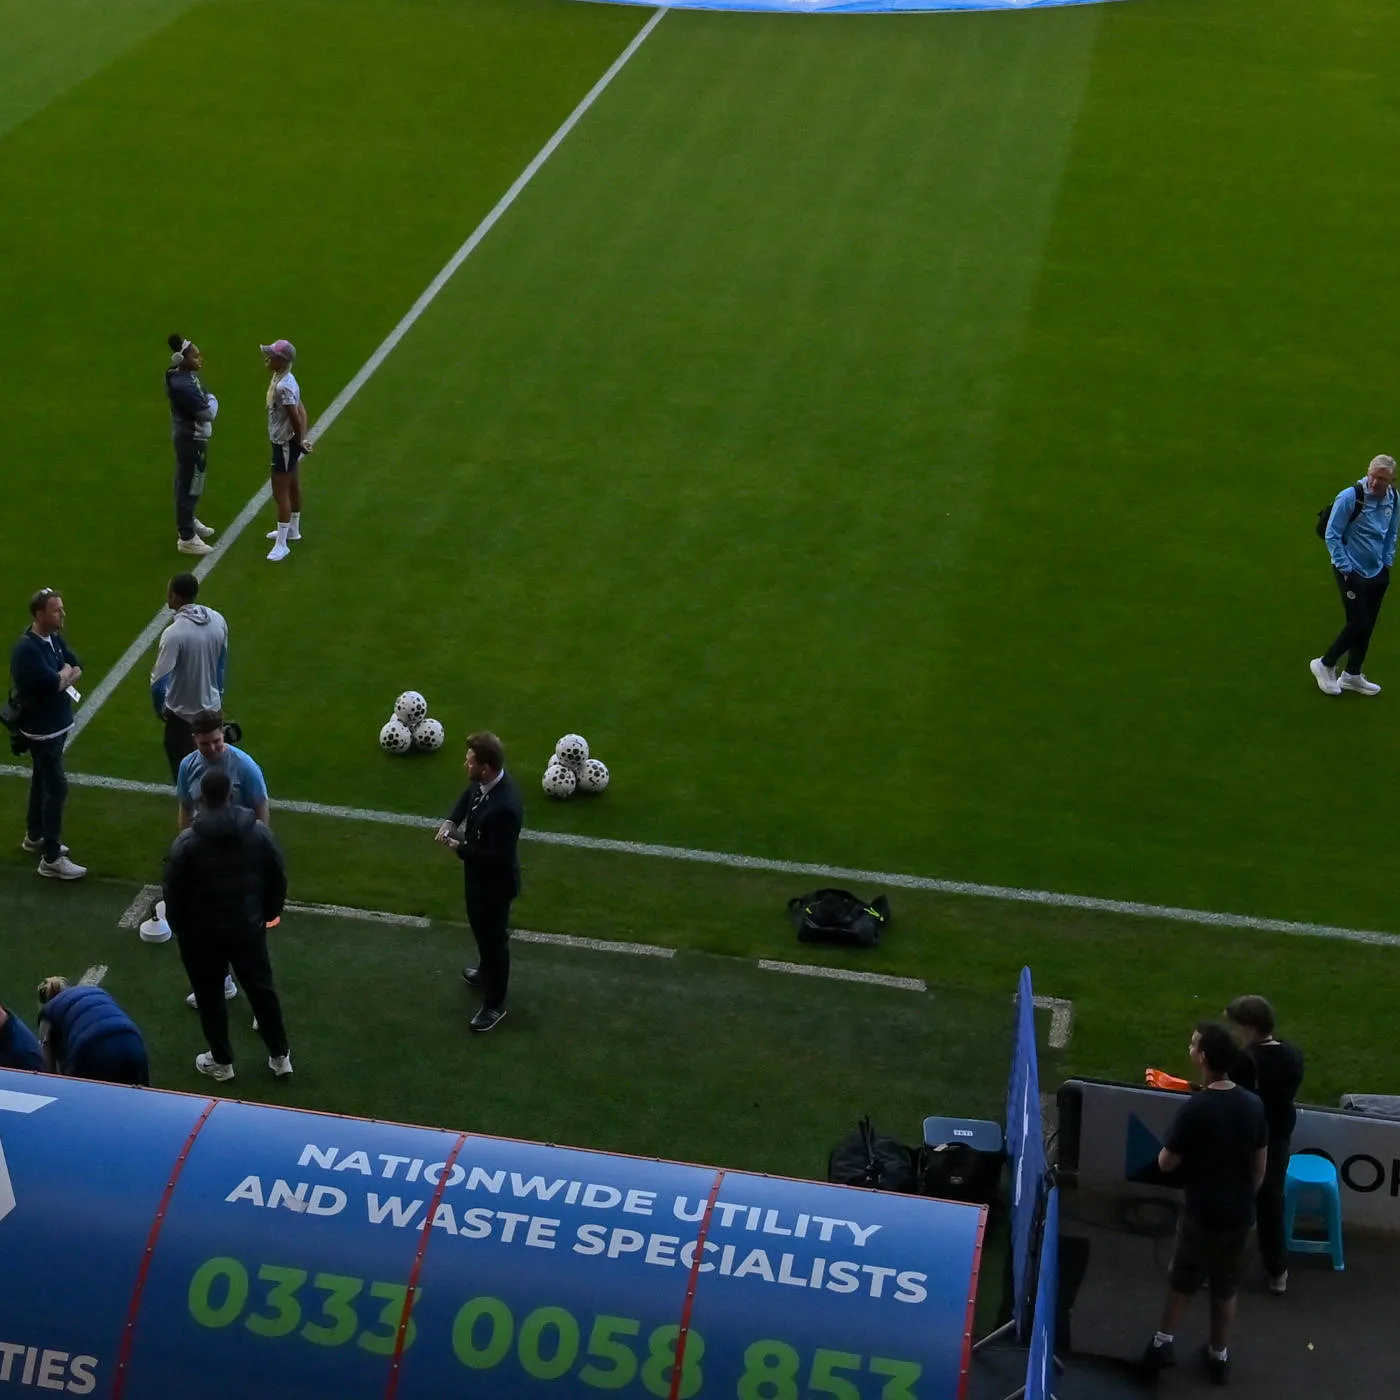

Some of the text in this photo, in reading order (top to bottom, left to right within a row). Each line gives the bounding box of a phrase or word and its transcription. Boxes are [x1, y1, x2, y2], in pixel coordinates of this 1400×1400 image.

[226, 1175, 930, 1304] AND WASTE SPECIALISTS
[298, 1143, 883, 1248] NATIONWIDE UTILITY
[187, 1255, 425, 1356] 0333
[451, 1296, 703, 1400] 0058
